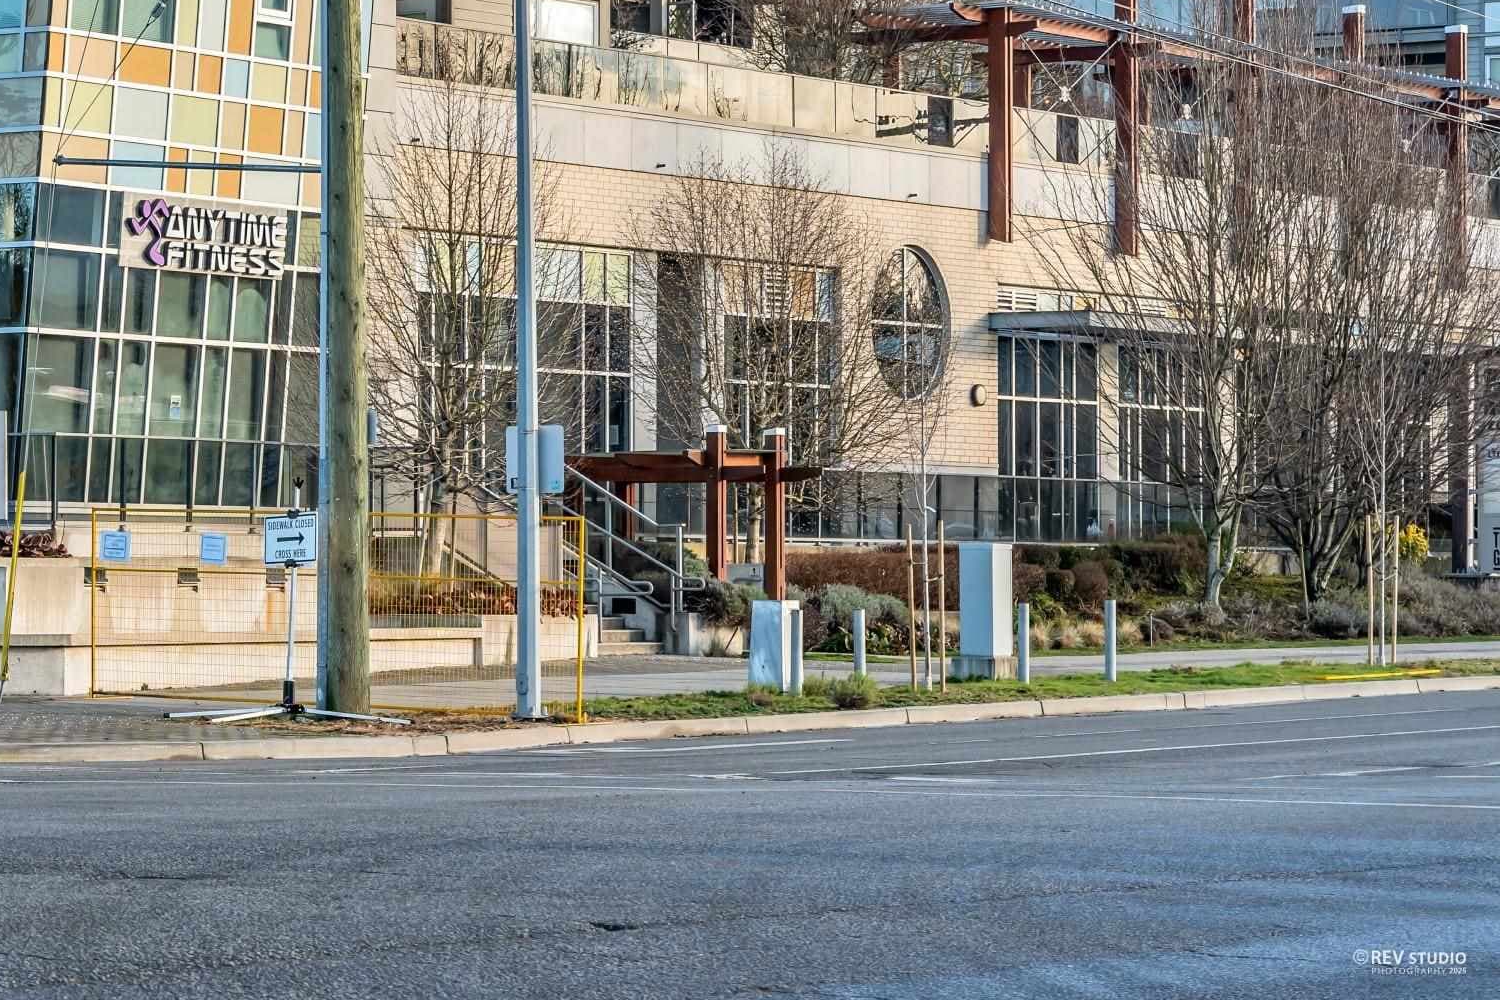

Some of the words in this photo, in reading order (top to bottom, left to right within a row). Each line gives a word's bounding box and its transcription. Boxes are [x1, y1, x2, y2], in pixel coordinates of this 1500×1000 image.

[165, 205, 288, 249] ANYTIME
[167, 241, 286, 275] FITNESS
[268, 519, 293, 530] SIDEWALK
[294, 518, 314, 529] CLOSED
[274, 550, 292, 559] CROSS
